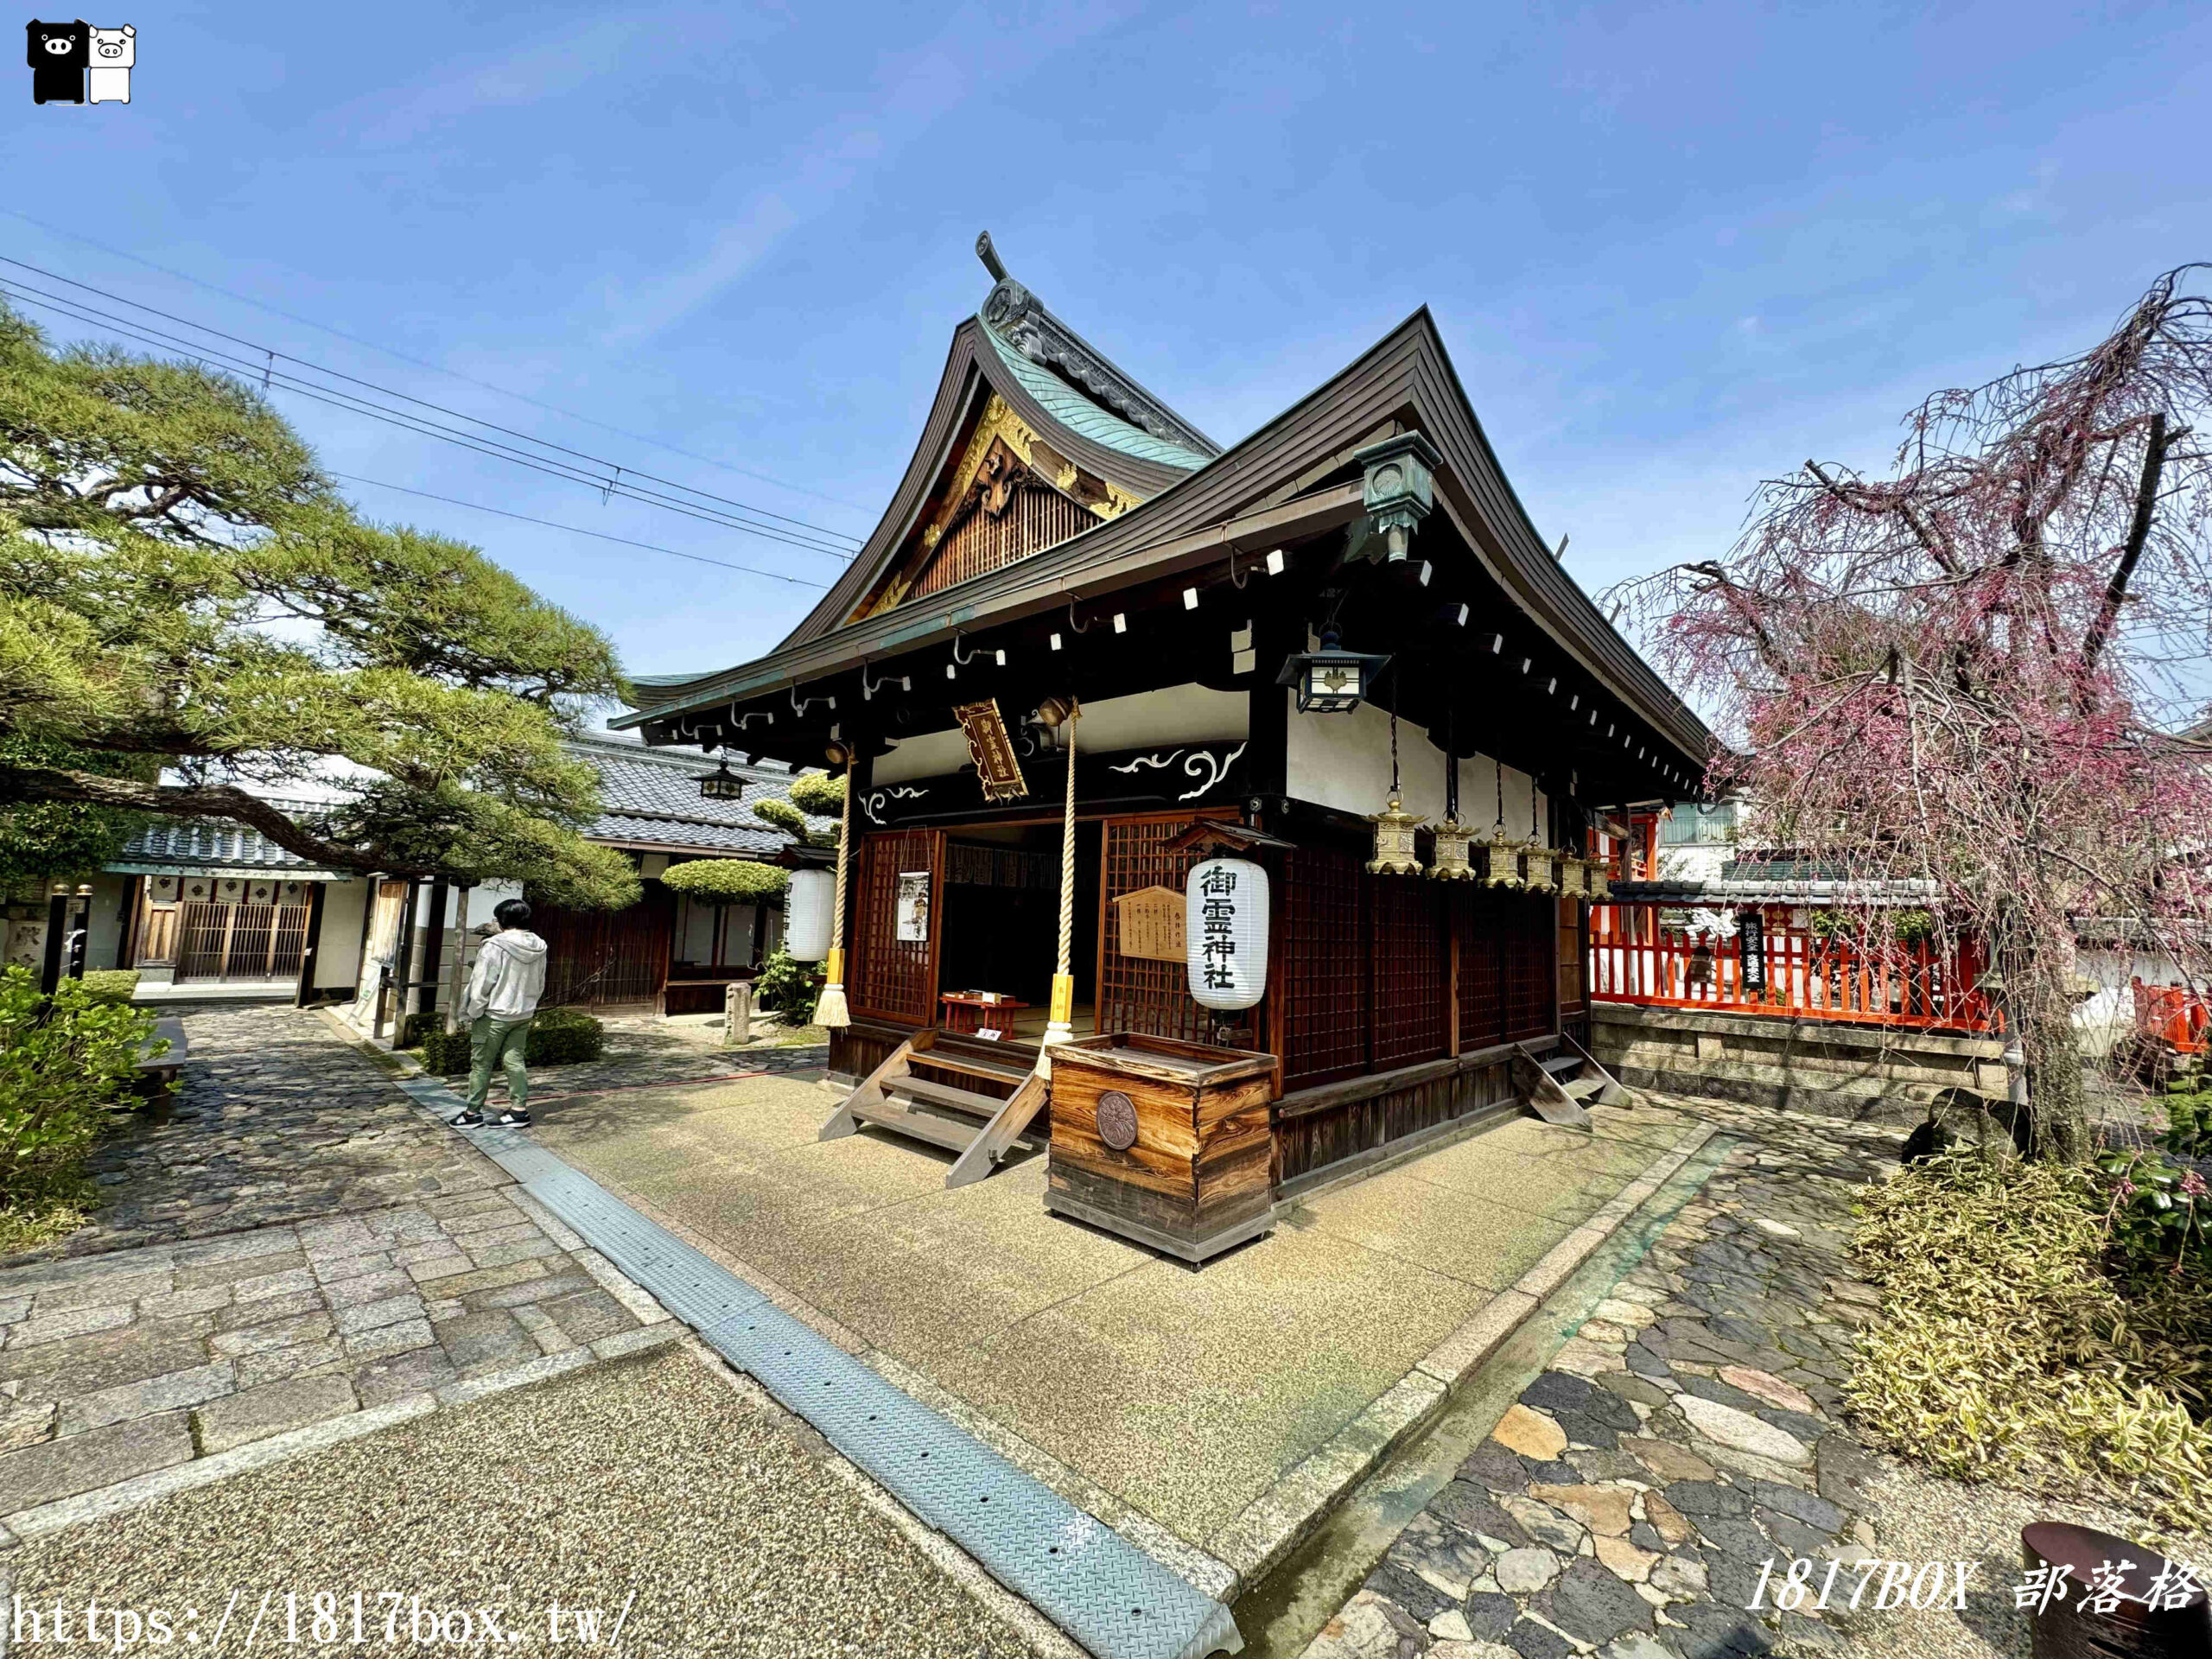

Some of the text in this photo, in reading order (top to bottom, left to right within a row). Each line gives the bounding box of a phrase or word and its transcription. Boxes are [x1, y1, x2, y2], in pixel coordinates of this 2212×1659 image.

[1199, 865, 1238, 990] 御霊神社
[1745, 921, 1759, 951] 旅行安全
